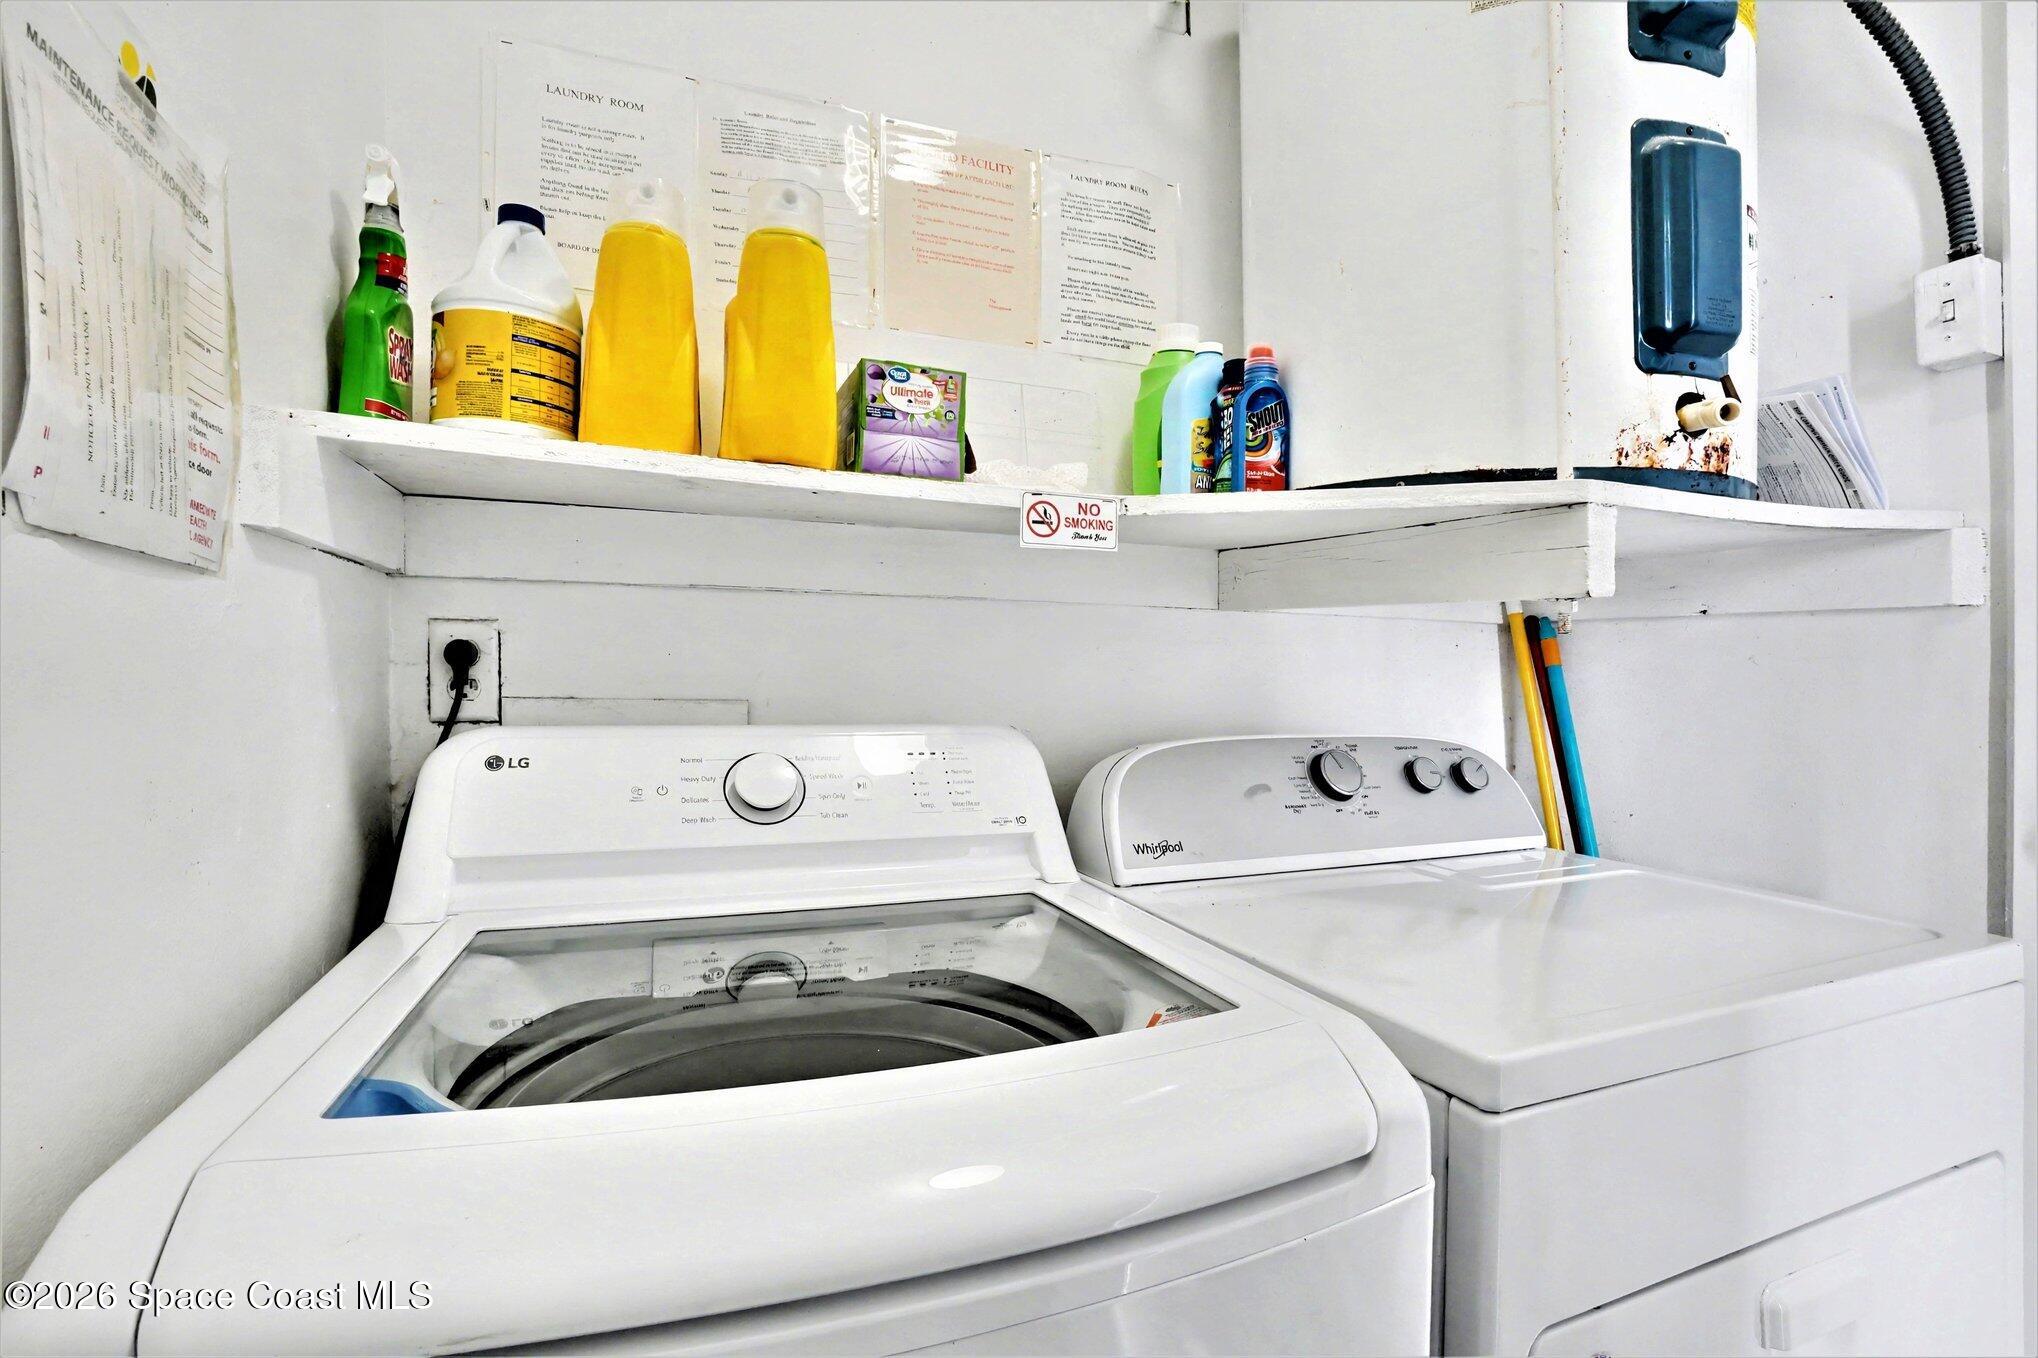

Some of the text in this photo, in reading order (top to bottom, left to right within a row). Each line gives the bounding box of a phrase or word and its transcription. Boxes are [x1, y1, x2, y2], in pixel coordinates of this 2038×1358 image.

[26, 22, 115, 129] MAINTENANCE
[116, 119, 163, 175] REQUEST
[546, 84, 645, 113] LAUNDRY ROOM
[961, 155, 1014, 175] FACILITY
[1070, 174, 1149, 196] LAUNDRY ROOM RULES
[557, 241, 582, 252] BOARD
[389, 327, 413, 361] SPRAY
[390, 355, 413, 384] WASH
[890, 386, 934, 399] Ultimate
[1248, 402, 1284, 432] SHOUT
[85, 420, 95, 462] NOTICE
[199, 443, 222, 465] form.
[196, 462, 213, 477] door
[1078, 502, 1101, 516] NO
[1064, 517, 1113, 531] SMOKING
[1071, 532, 1107, 542] Thank You
[508, 757, 530, 769] LG
[1133, 840, 1184, 859] Whirlpool
